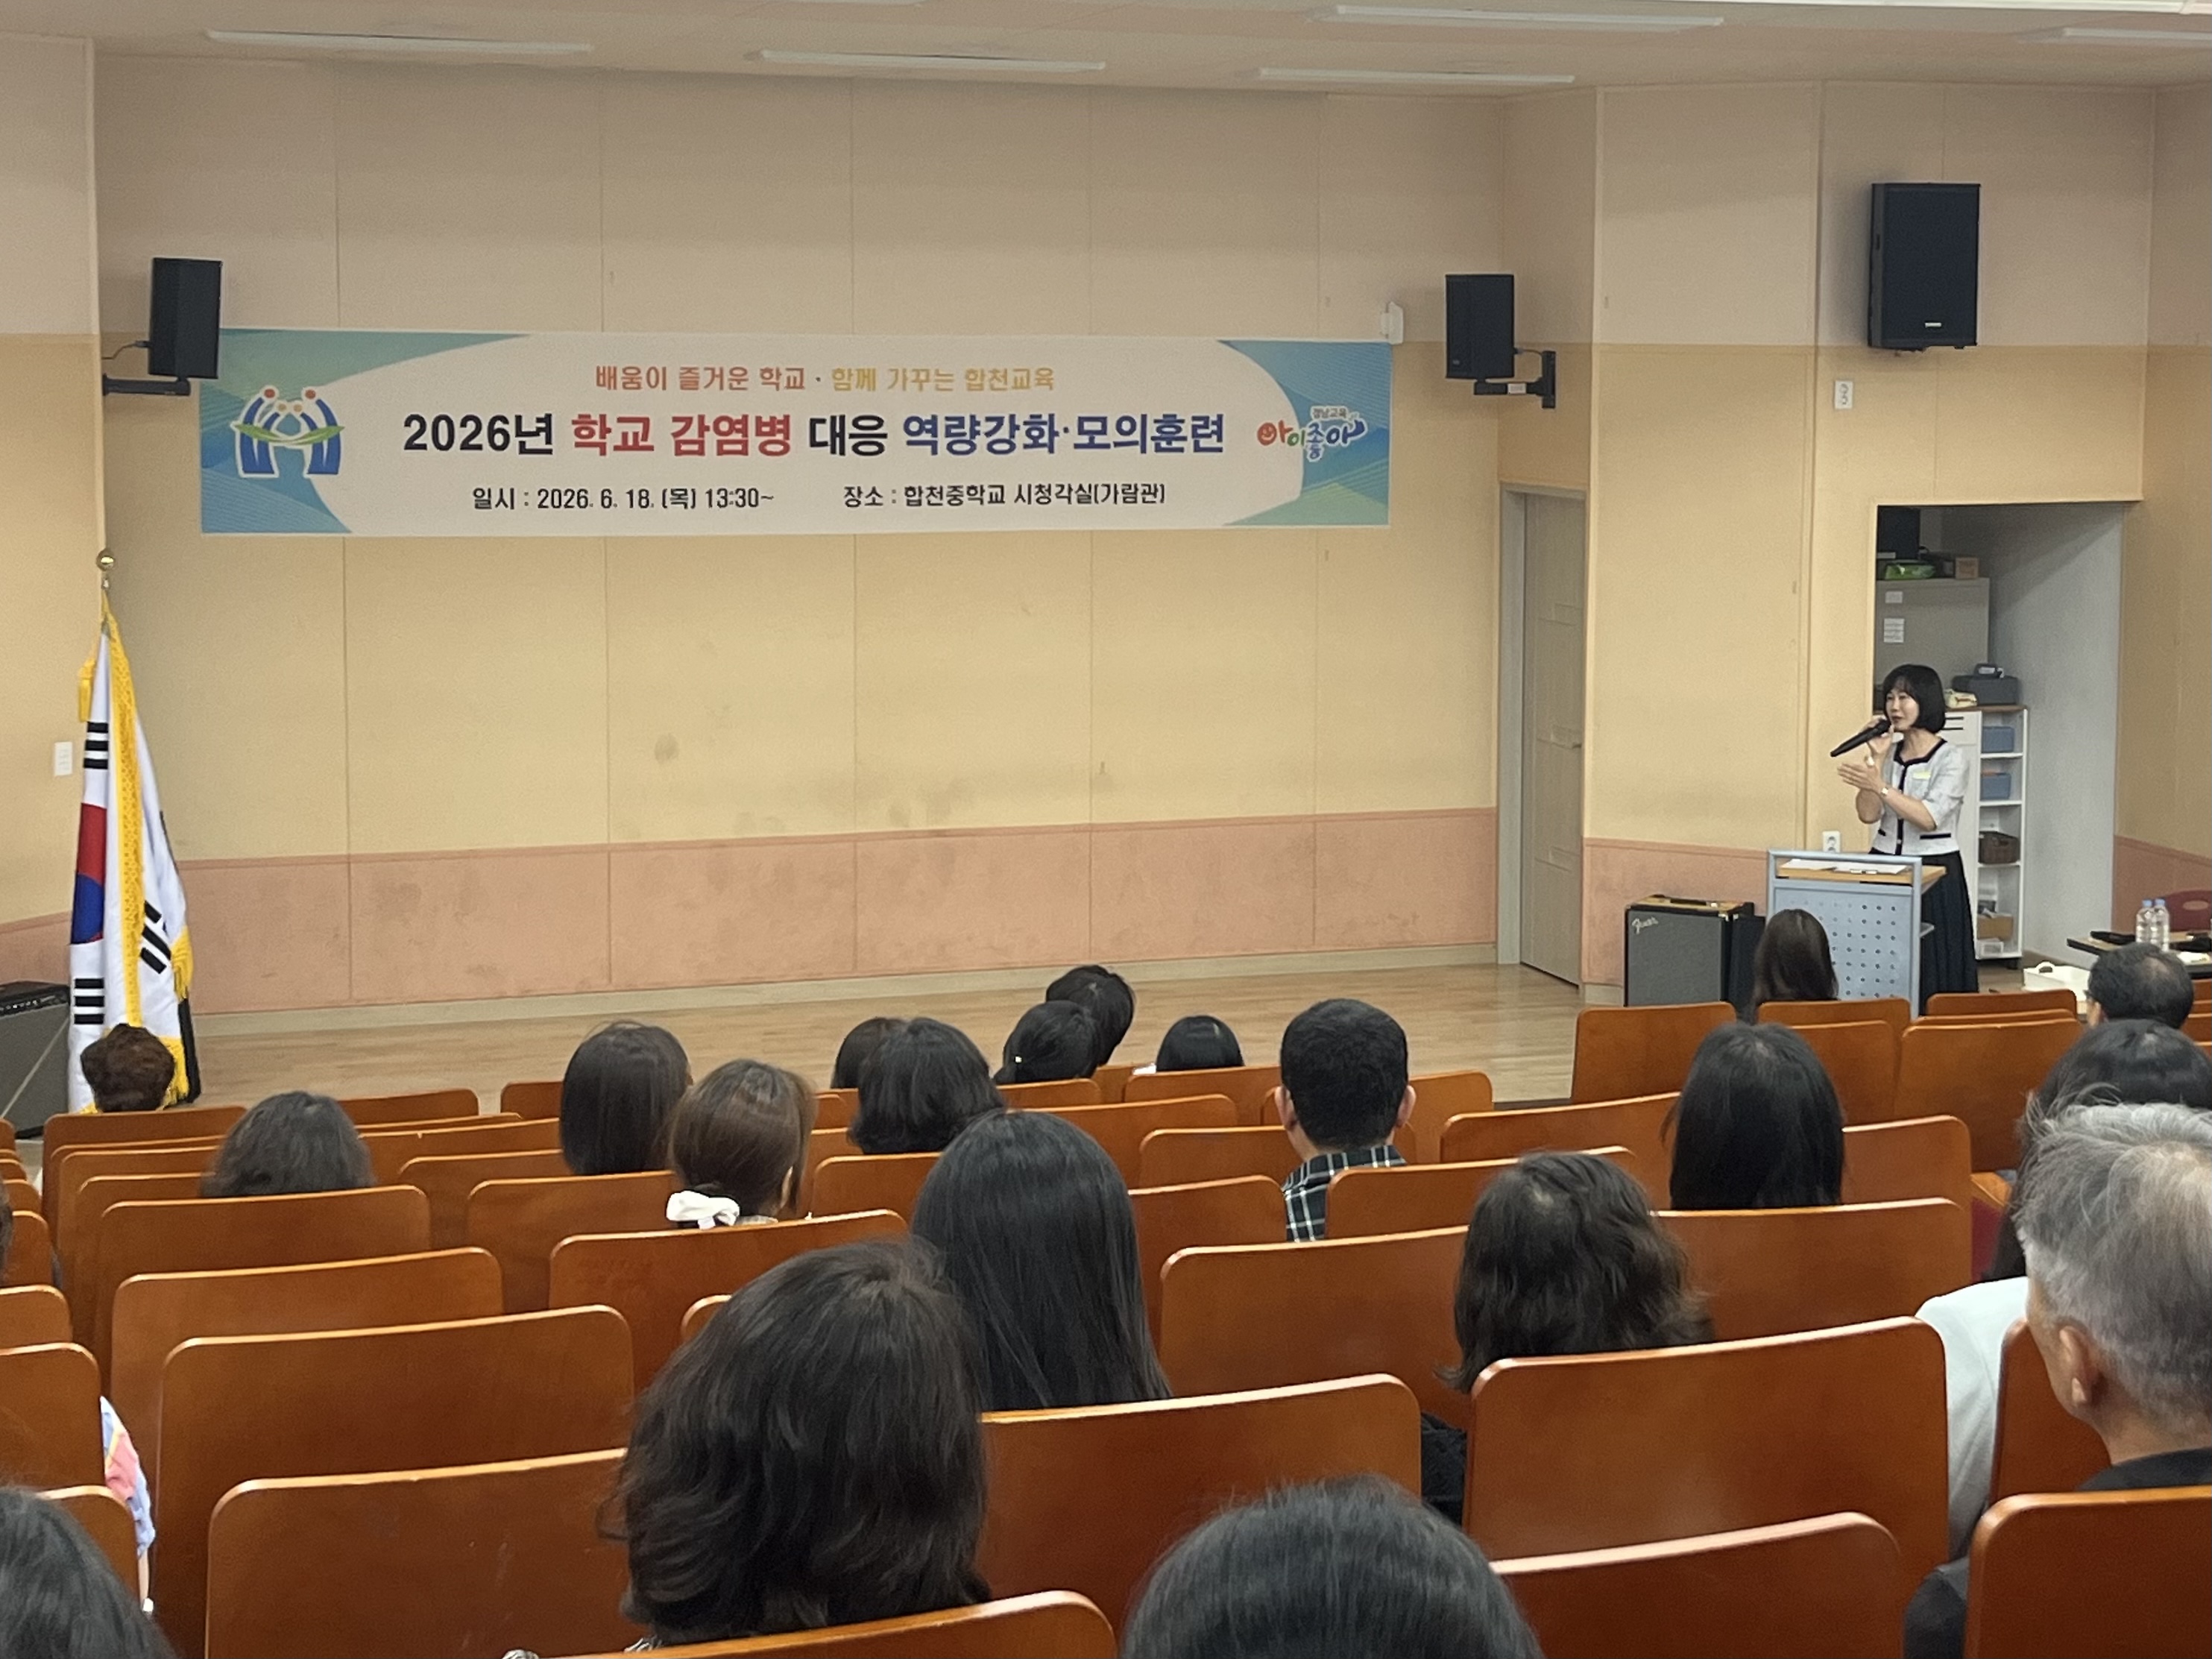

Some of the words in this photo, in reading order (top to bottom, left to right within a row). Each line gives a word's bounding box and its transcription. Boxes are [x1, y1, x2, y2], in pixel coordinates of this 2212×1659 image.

[595, 366, 667, 391] 배움이
[679, 367, 749, 391] 즐거운
[760, 367, 805, 392] 학교
[832, 368, 877, 392] 함께
[887, 368, 955, 392] 가꾸는
[965, 368, 1054, 392] 합천교육
[403, 413, 555, 456] 2026년
[571, 414, 655, 458] 학교
[670, 415, 793, 458] 감염병
[809, 414, 889, 458] 대응
[903, 413, 1225, 457] 역량강화·모의훈련
[472, 487, 516, 511] 일시
[537, 488, 595, 511] 2026.
[600, 488, 620, 511] 6.
[626, 488, 656, 511] 18.
[705, 488, 775, 510] 13:30~
[844, 485, 885, 509] 장소
[904, 484, 1006, 509] 합천중학교
[1014, 482, 1167, 508] 시청각실(가람관)
